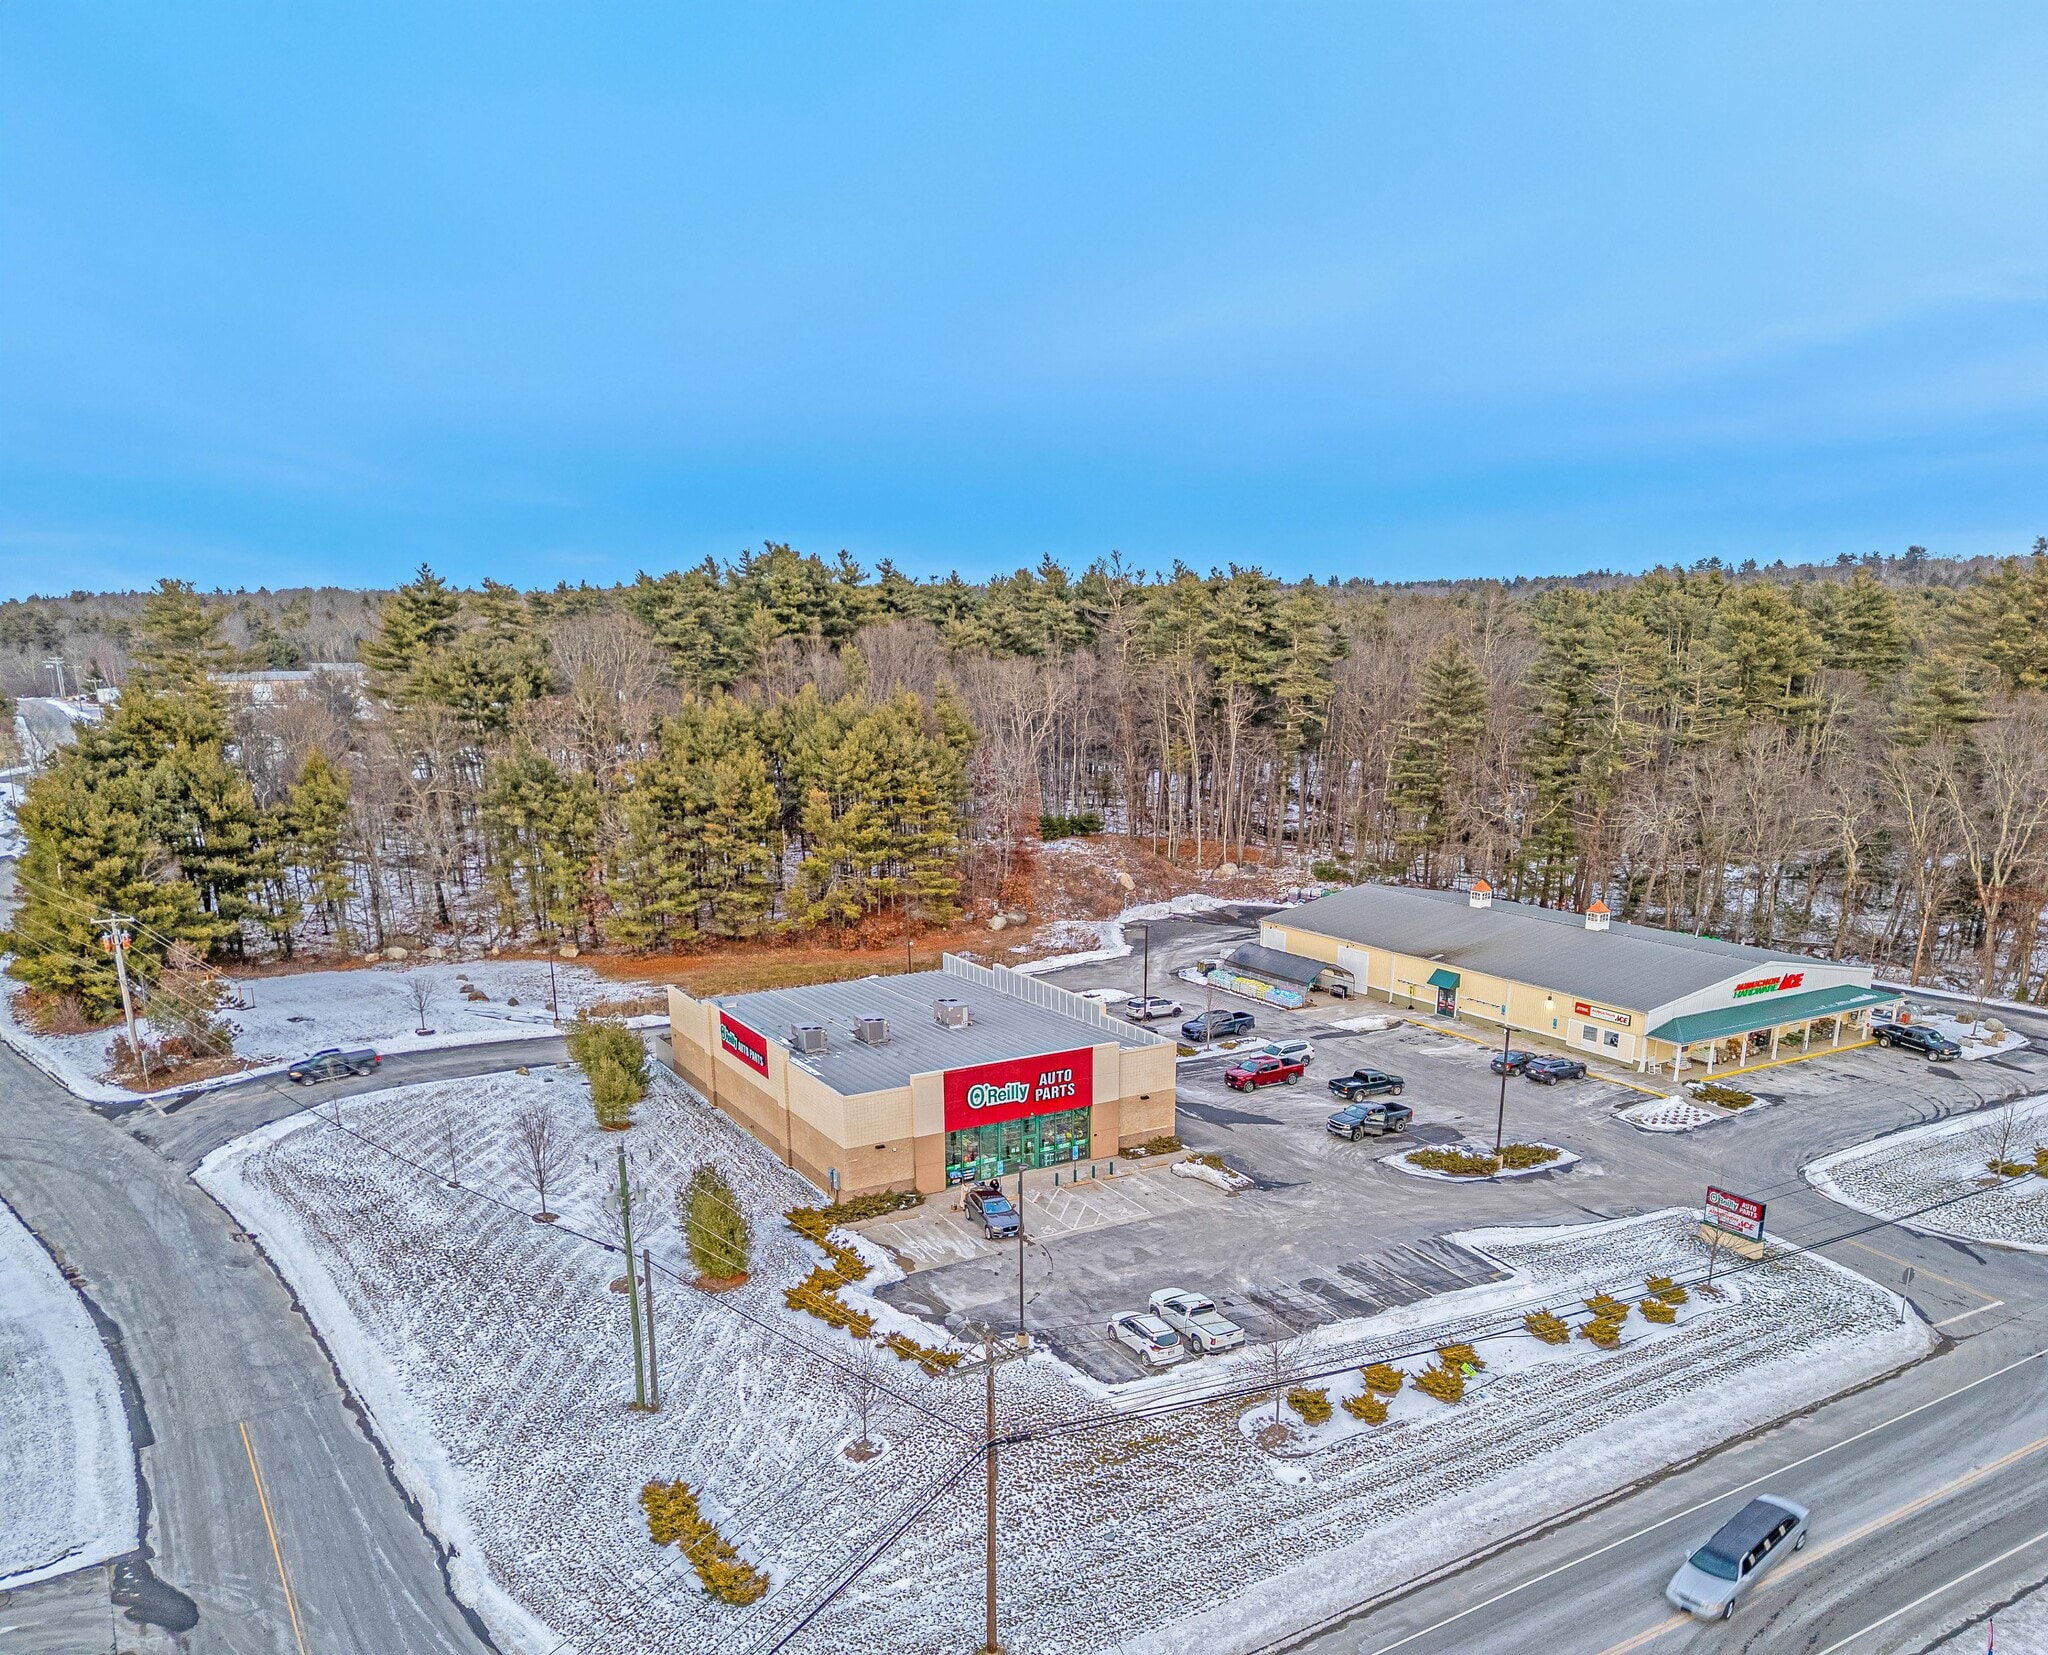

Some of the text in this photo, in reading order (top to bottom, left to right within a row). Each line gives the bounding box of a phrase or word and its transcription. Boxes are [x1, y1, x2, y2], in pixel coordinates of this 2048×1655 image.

[1778, 973, 1804, 990] ACE
[1733, 984, 1779, 998] HARDWARE
[1615, 1015, 1628, 1024] ACE
[1039, 1069, 1072, 1086] AUTO
[968, 1082, 1030, 1109] O'Reilly
[1035, 1083, 1075, 1101] PARTS
[1740, 1208, 1758, 1218] PARTS
[1742, 1202, 1757, 1212] AUTO
[1738, 1220, 1755, 1231] ACE
